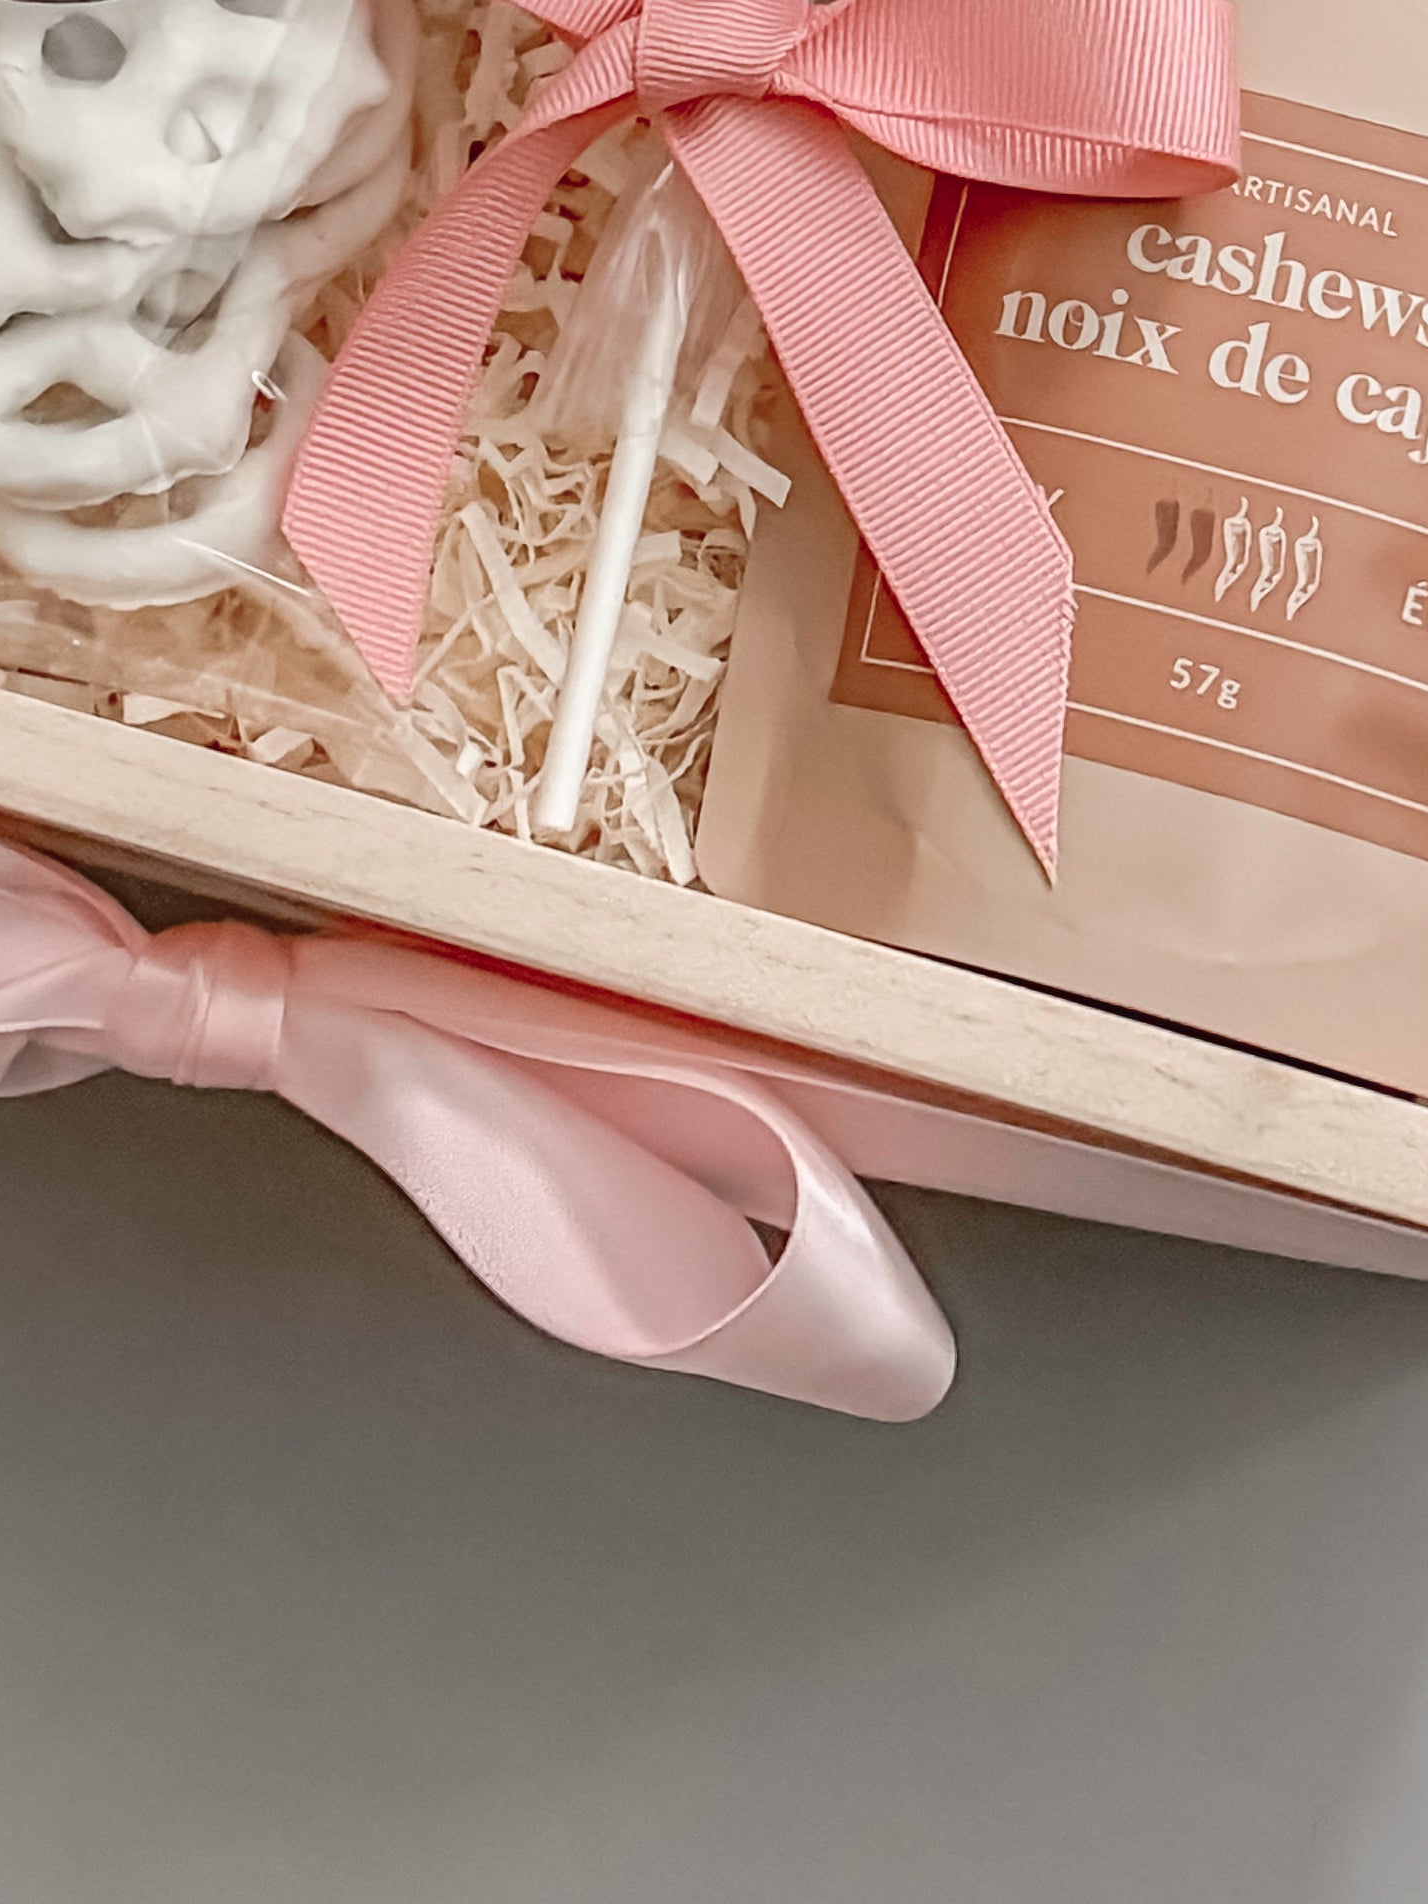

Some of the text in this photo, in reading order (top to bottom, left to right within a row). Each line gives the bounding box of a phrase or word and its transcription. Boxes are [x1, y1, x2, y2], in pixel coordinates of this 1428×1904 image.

[994, 288, 1183, 377] noix
[1207, 320, 1311, 406] de
[1169, 656, 1242, 711] 57g
